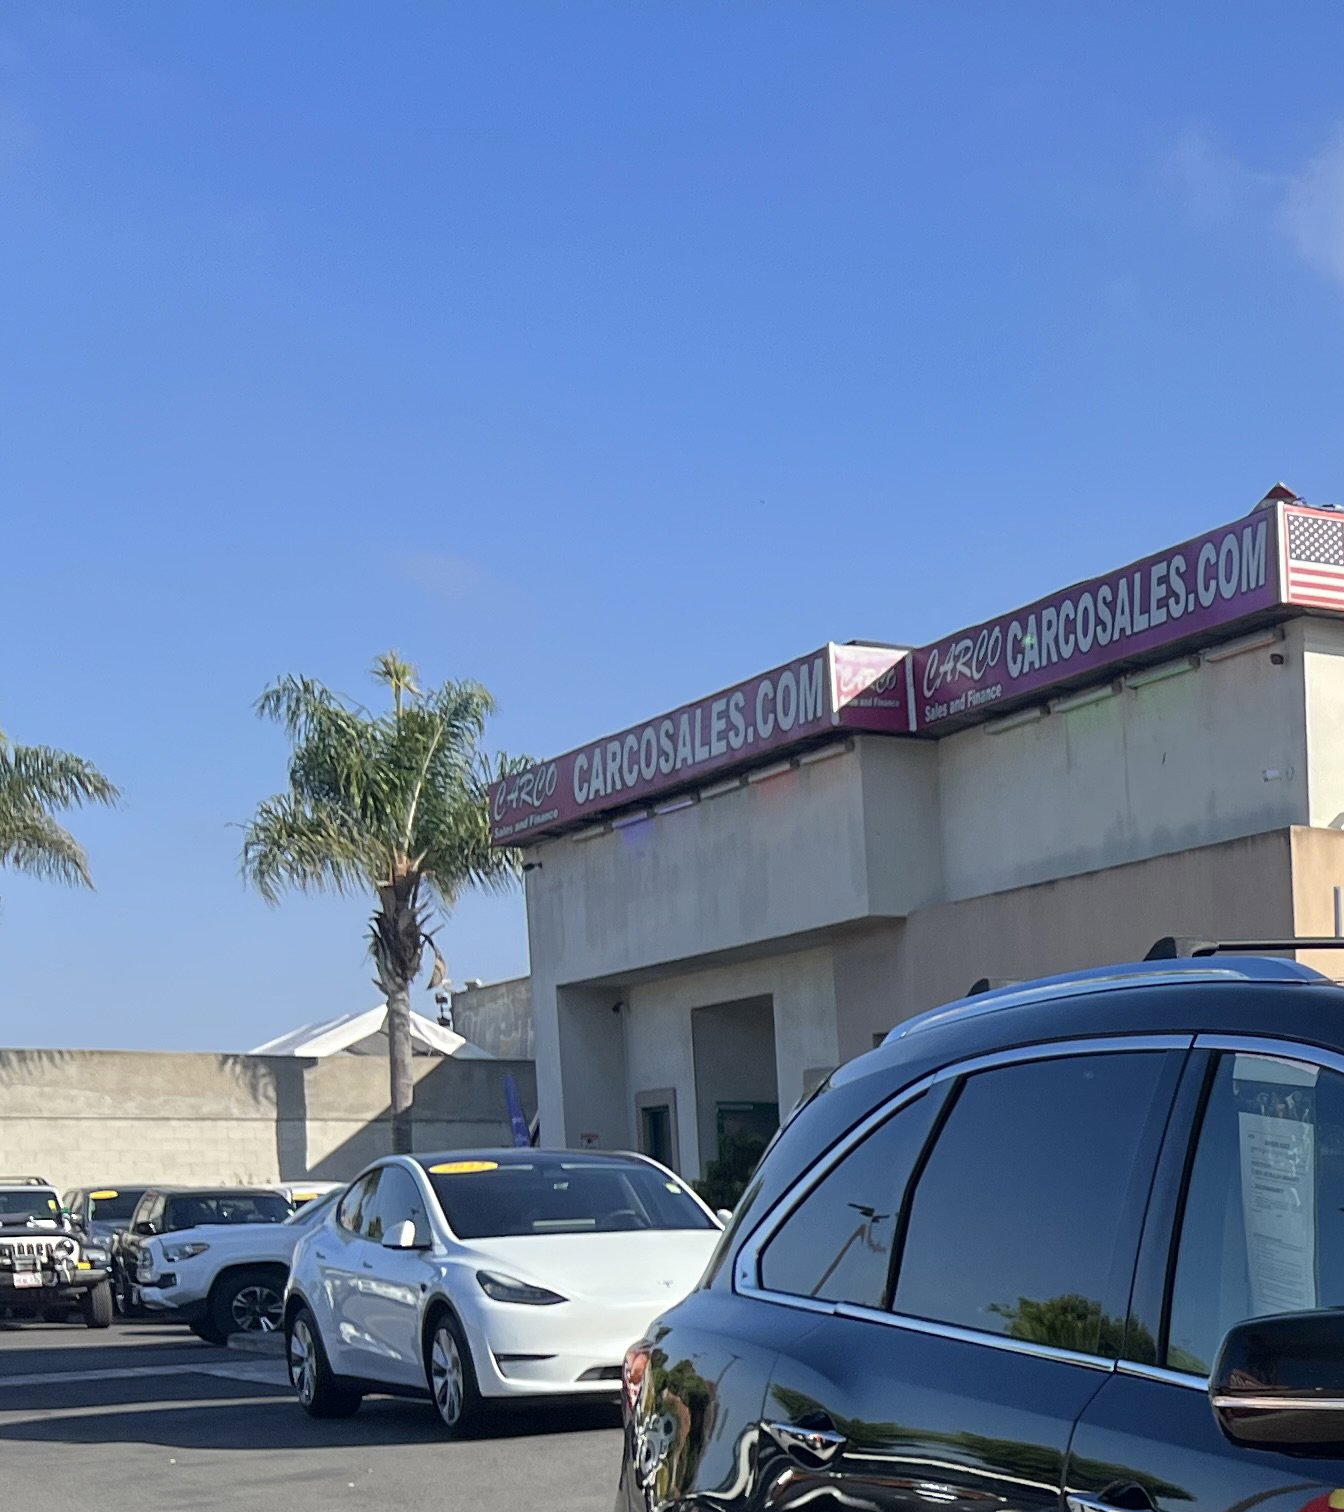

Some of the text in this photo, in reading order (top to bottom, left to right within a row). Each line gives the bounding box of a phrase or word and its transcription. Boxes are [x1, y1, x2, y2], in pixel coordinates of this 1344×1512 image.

[1007, 521, 1267, 678] CARCOSALES.COM
[923, 626, 1002, 698] CARCO
[573, 657, 824, 804] CARCOSALES.COM
[925, 683, 1002, 722] Sales and Finance
[494, 762, 558, 821] CARCO
